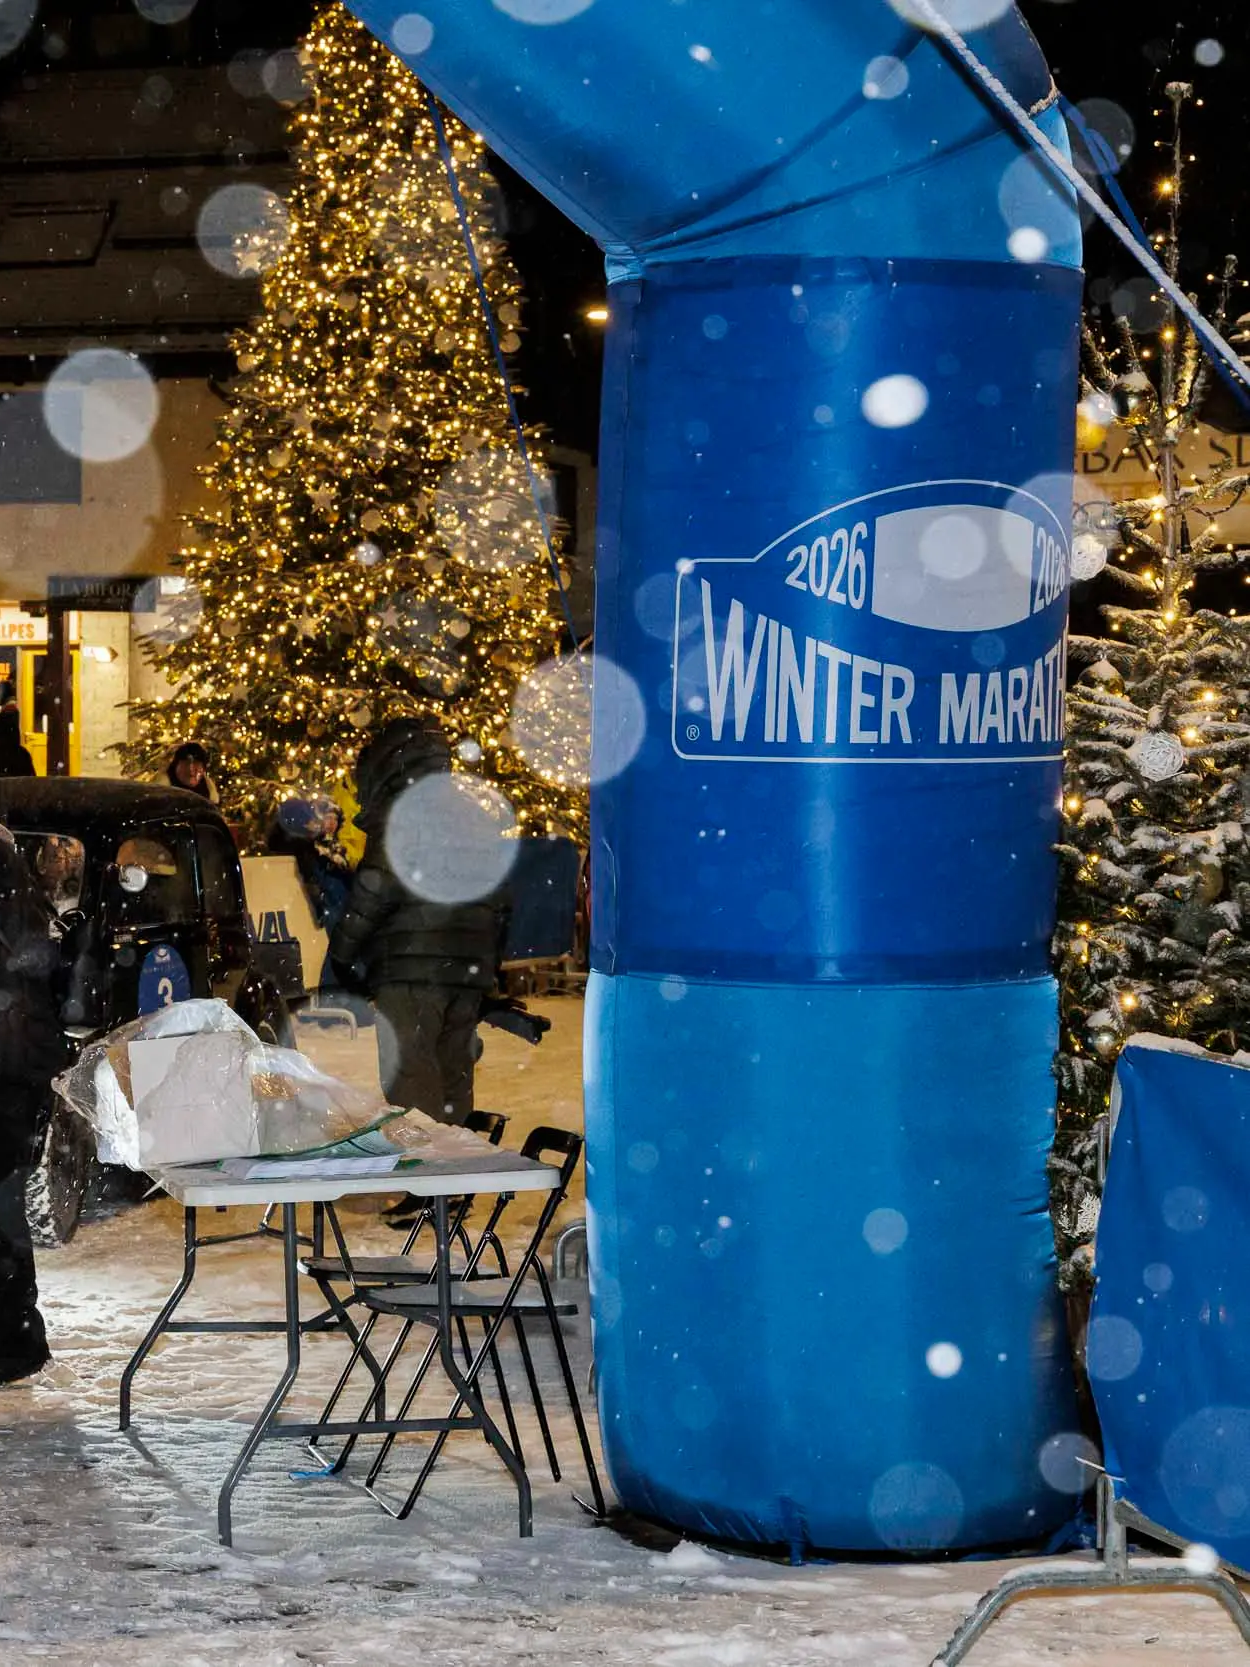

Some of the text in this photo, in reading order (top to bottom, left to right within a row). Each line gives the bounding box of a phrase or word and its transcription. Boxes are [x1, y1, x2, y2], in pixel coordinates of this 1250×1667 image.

[785, 521, 868, 610] 2026
[1033, 527, 1066, 614] 2026
[701, 577, 915, 744] WINTER
